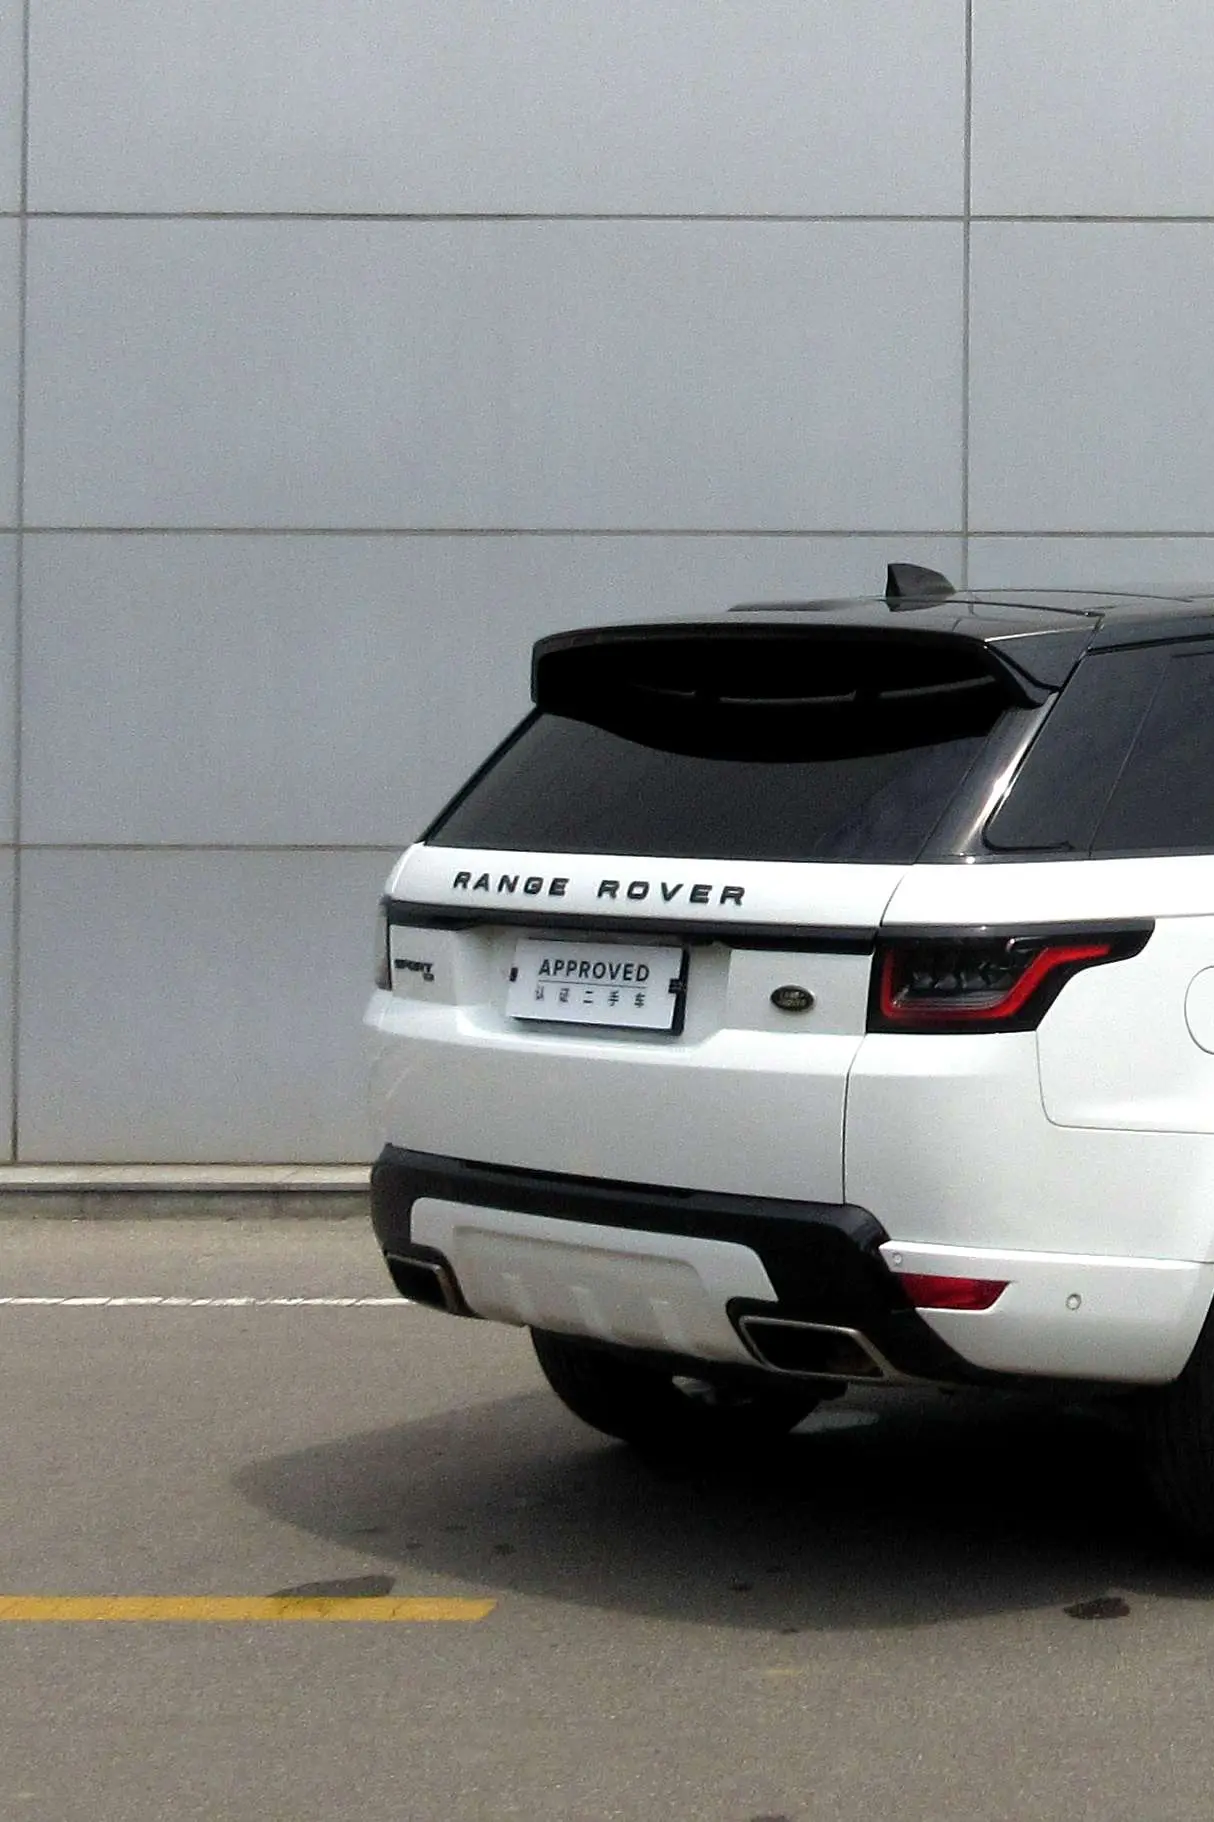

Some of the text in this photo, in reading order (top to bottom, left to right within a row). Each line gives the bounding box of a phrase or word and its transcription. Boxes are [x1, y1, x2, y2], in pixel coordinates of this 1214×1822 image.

[453, 871, 745, 906] RANGE ROVER
[539, 959, 650, 982] APPROVED
